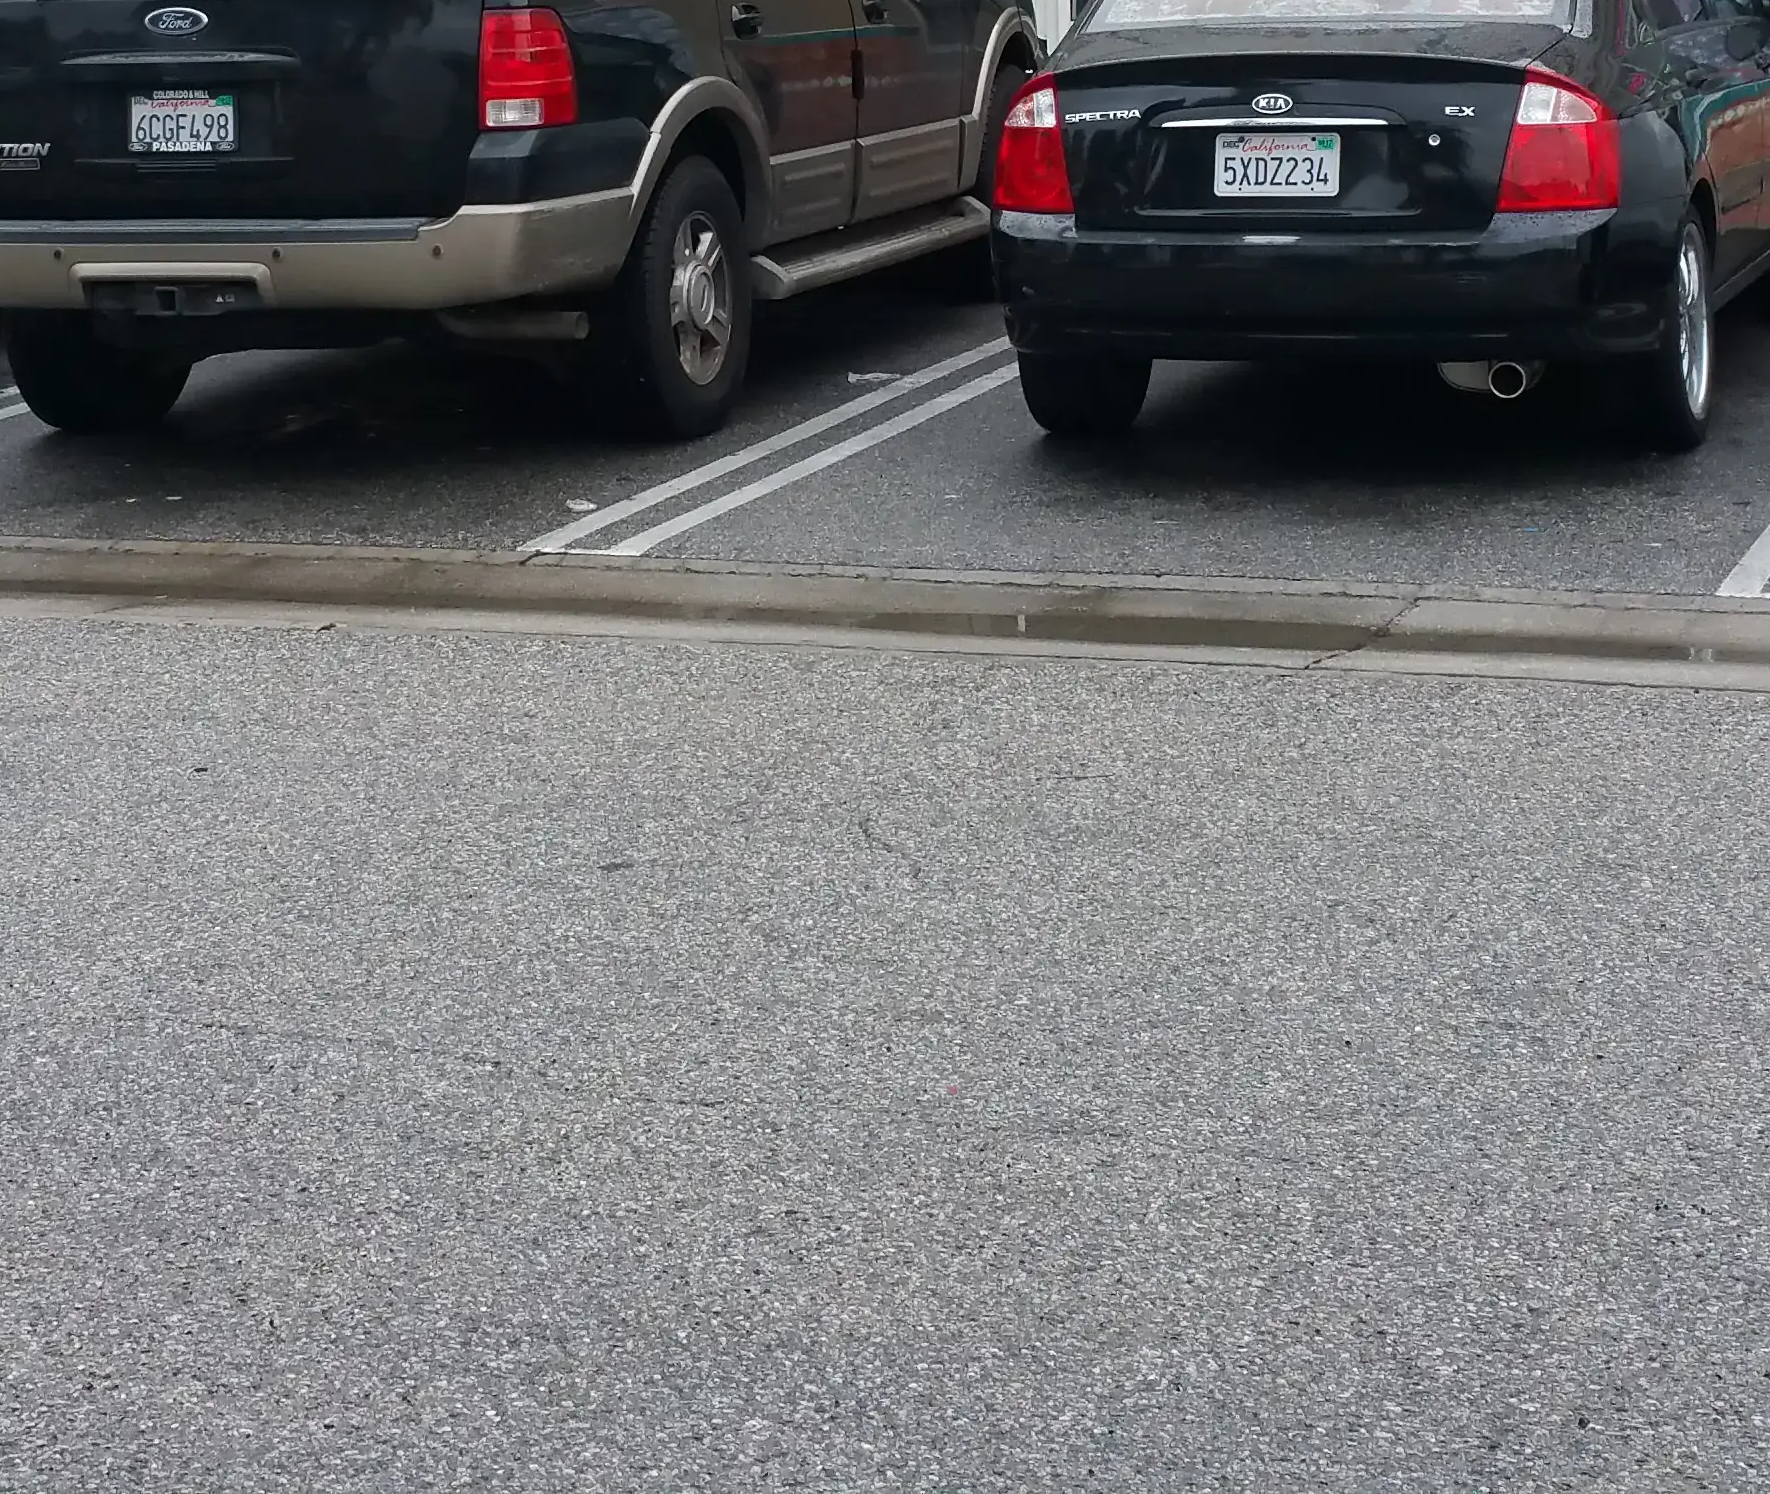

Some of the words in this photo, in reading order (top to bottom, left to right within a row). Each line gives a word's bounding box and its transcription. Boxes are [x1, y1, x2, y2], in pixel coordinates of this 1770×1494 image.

[158, 12, 193, 29] Ford
[1258, 98, 1286, 109] KIA
[1065, 109, 1141, 124] SPECTRA
[1445, 106, 1476, 117] EX
[135, 113, 229, 142] 6CGF498
[152, 142, 213, 152] PASADENA
[1241, 138, 1317, 156] California
[1223, 156, 1330, 187] 5XDZ234
